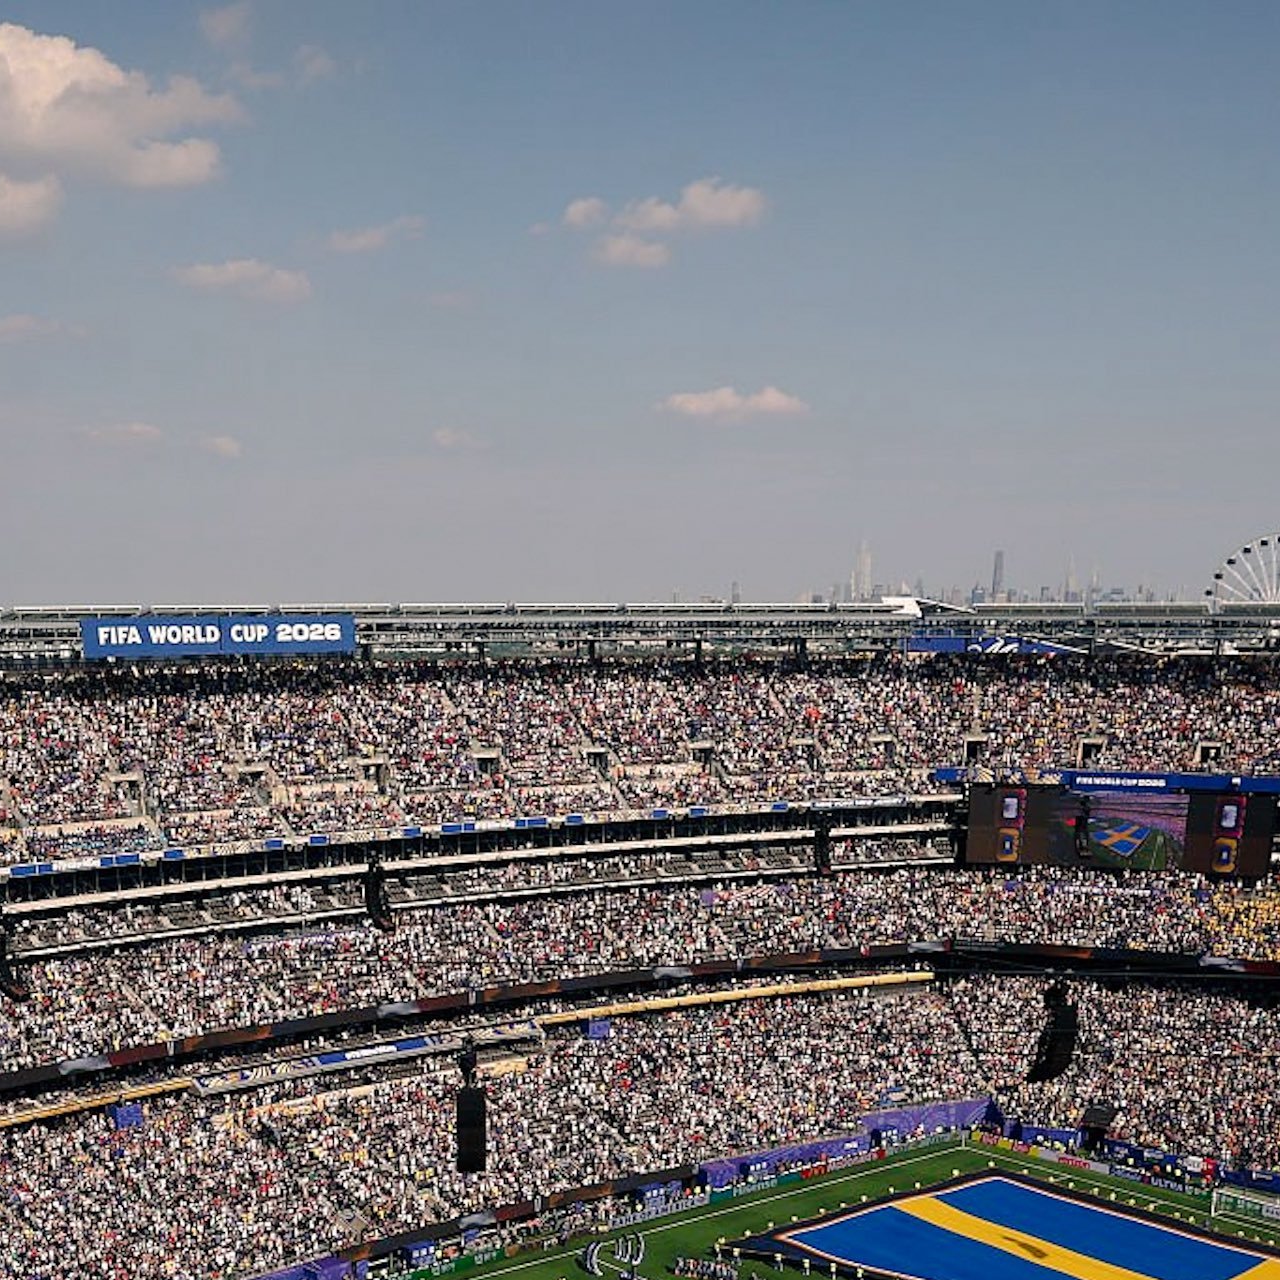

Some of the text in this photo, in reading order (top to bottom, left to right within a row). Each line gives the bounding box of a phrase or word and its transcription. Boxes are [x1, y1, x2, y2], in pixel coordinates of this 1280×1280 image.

[98, 623, 342, 645] FIFA WORLD CUP 2026
[733, 1179, 778, 1197] Hisense
